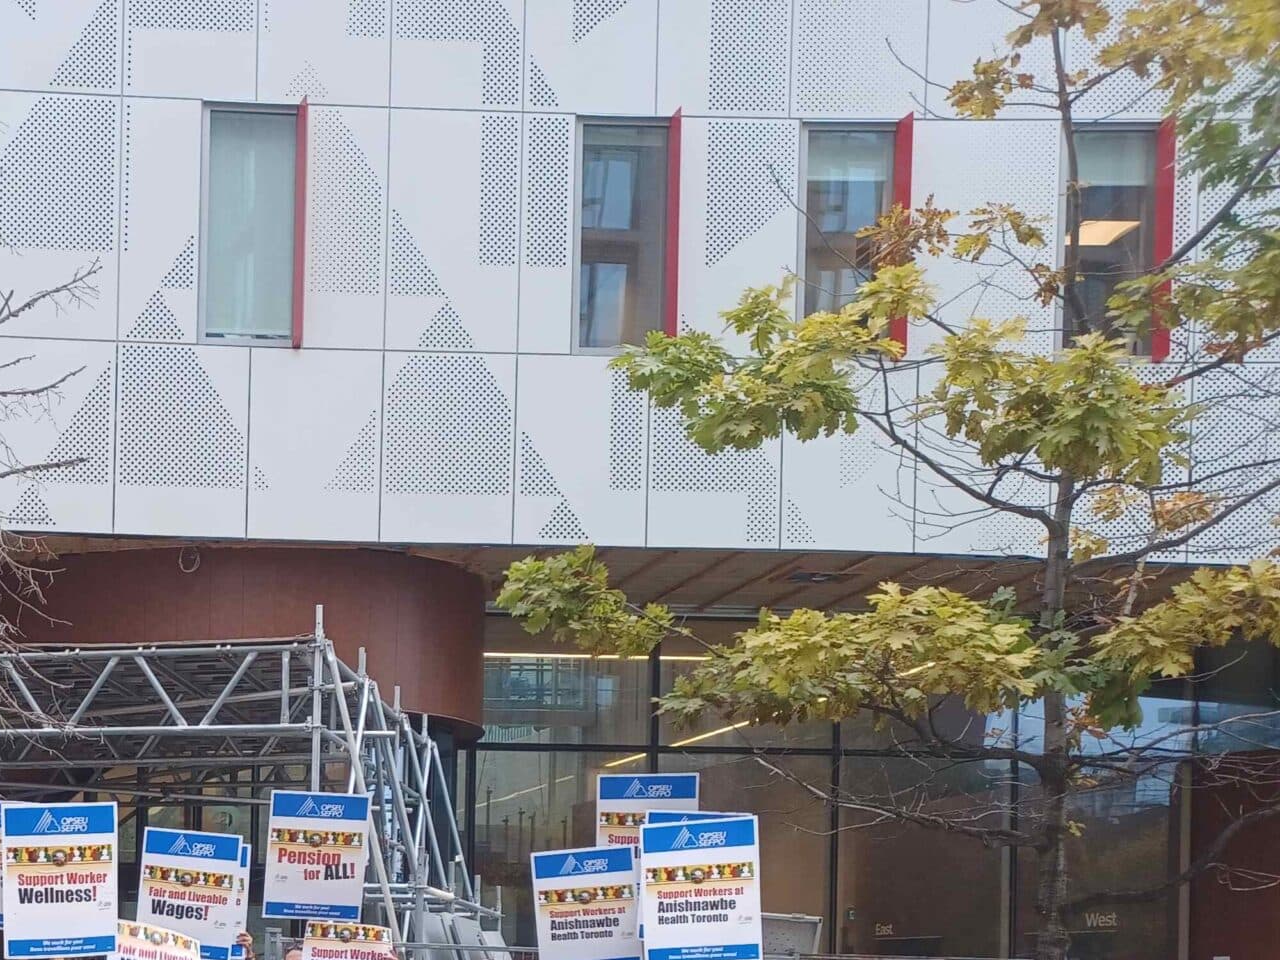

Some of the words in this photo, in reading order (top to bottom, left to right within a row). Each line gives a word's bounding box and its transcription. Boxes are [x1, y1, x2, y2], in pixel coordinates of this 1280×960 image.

[608, 834, 639, 845] Suppo
[278, 848, 341, 866] Pension
[304, 869, 320, 880] for
[324, 863, 355, 880] ALL!
[18, 873, 64, 886] Support
[66, 872, 107, 885] Worker
[18, 886, 97, 904] Wellness!
[148, 886, 167, 897] Fair
[168, 889, 186, 900] and
[188, 890, 228, 905] Liveable
[657, 889, 692, 899] Support
[694, 887, 732, 897] Workers
[734, 887, 744, 895] at
[151, 899, 209, 920] Wages!
[657, 898, 736, 913] Anishnawbe
[549, 910, 580, 918] Support
[582, 908, 616, 916] Workers
[658, 914, 689, 925] Health
[690, 913, 728, 923] Toronto
[1085, 912, 1117, 927] West
[550, 916, 619, 931] Anishnawbe
[875, 923, 893, 935] East
[551, 932, 579, 941] Health
[580, 930, 613, 939] Toronto
[138, 947, 157, 960] and
[311, 947, 348, 959] Support
